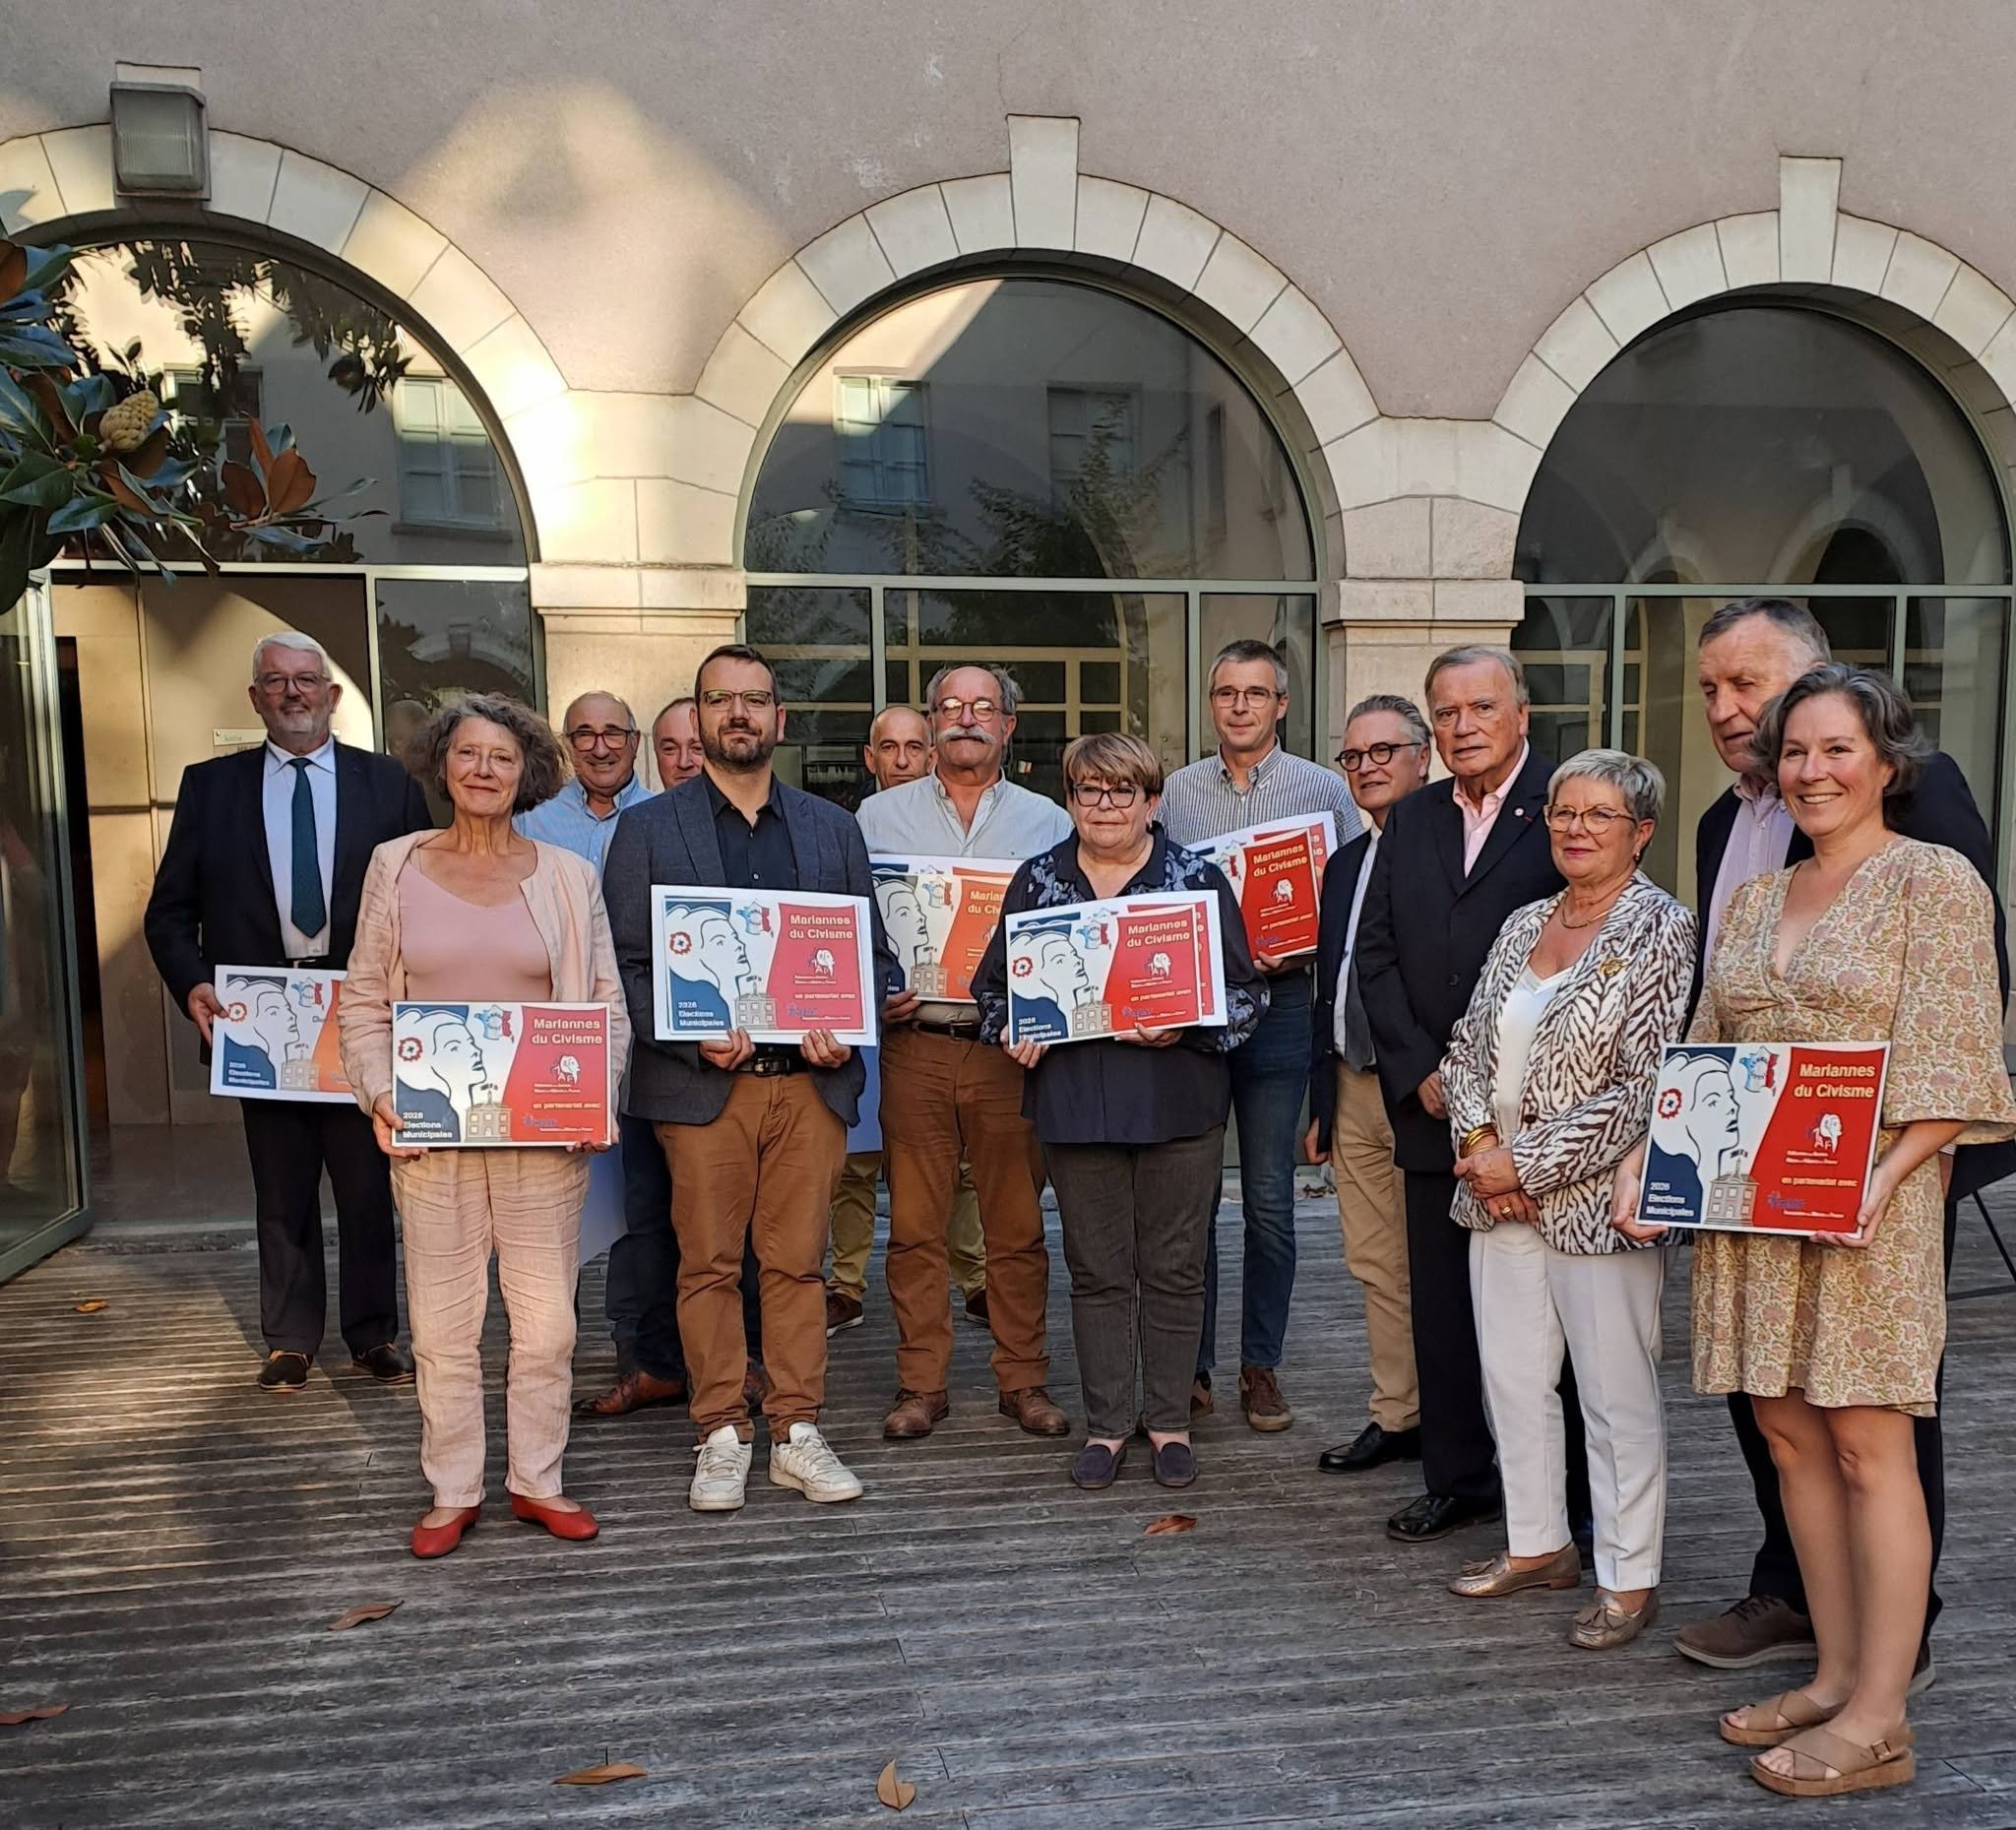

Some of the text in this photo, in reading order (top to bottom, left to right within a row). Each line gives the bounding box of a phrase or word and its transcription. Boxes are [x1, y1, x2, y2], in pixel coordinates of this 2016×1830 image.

[1253, 845, 1304, 864] Mariannes
[1253, 856, 1308, 877] du Civisme
[969, 890, 1004, 900] Maria
[967, 904, 981, 915] du
[789, 914, 850, 925] Mariannes
[1127, 919, 1188, 935] Mariannes
[788, 928, 854, 939] du Civisme
[1126, 931, 1190, 948] du Civisme
[534, 1018, 601, 1030] Mariannes
[532, 1033, 603, 1044] du Civisme
[1798, 1063, 1876, 1078] Mariannes
[1794, 1084, 1876, 1098] du Civisme
[402, 1130, 453, 1140] Municipales
